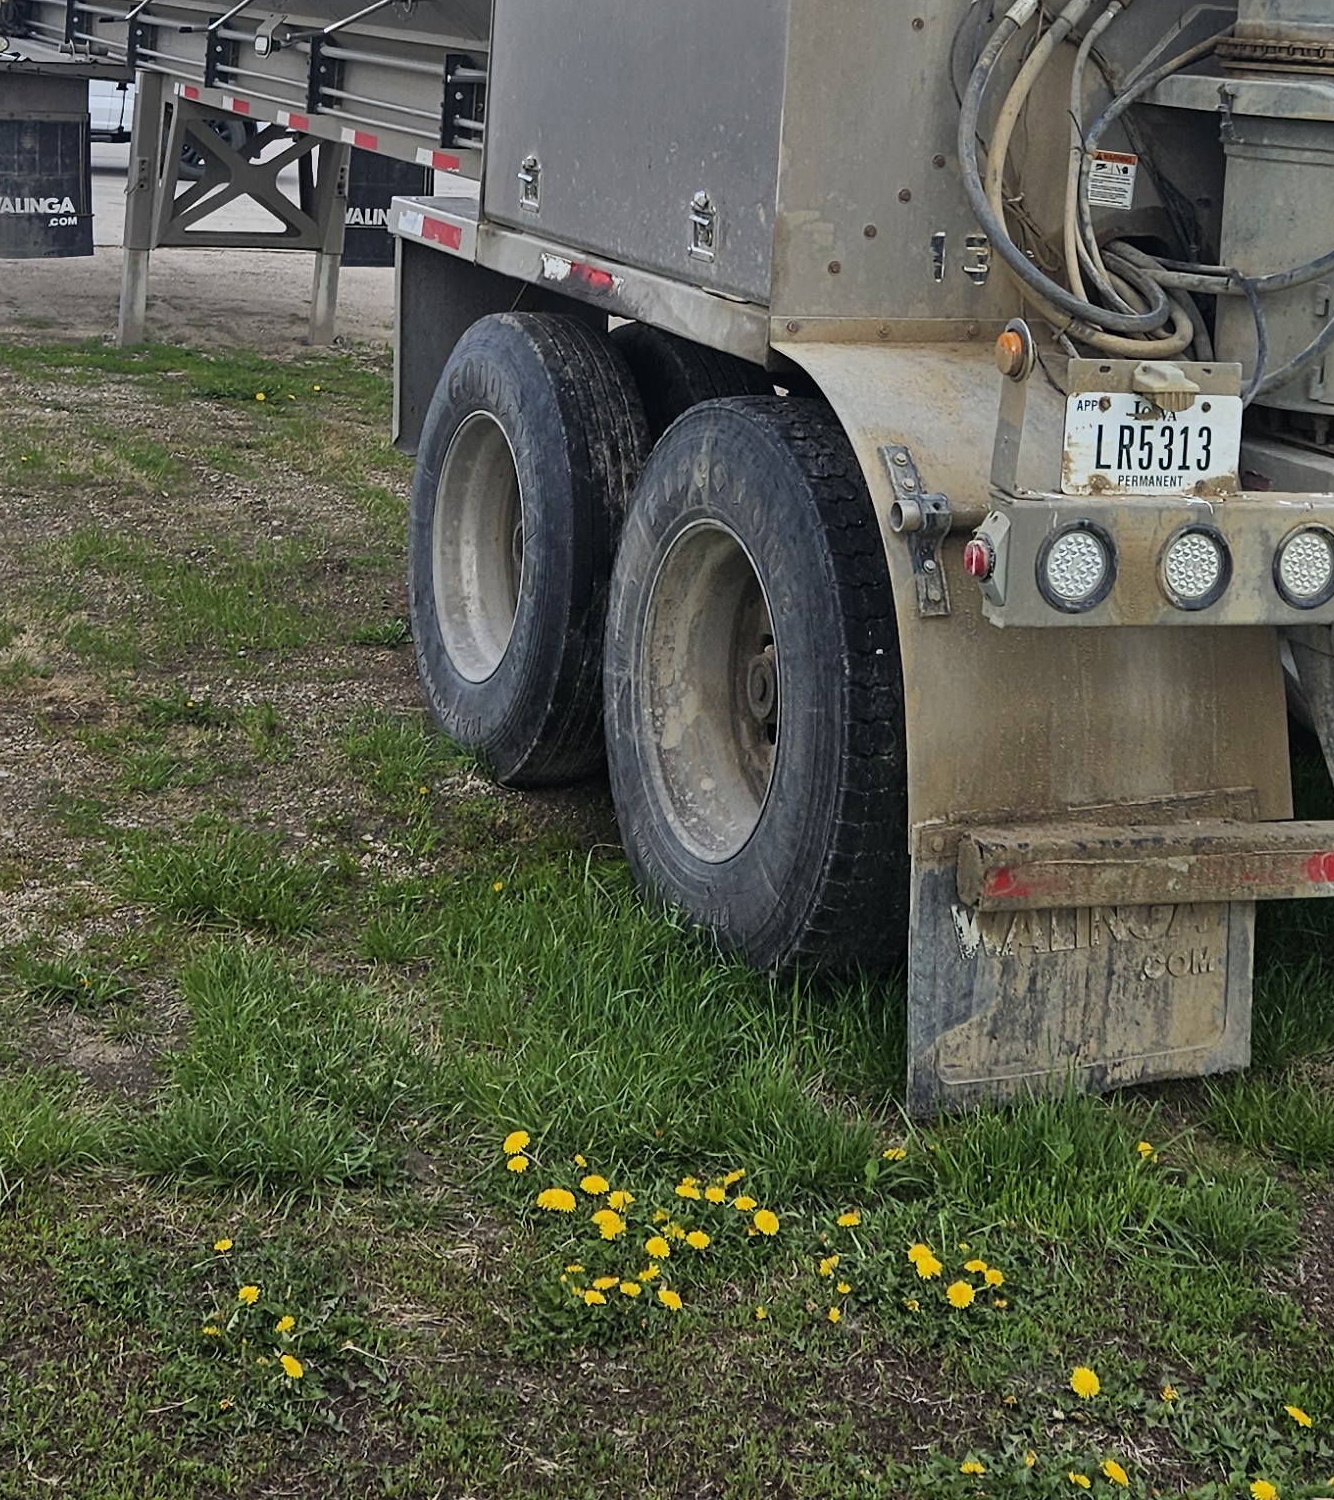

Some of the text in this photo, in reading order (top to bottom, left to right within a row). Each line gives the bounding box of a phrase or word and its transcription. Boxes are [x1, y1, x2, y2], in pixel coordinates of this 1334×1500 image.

[48, 216, 78, 227] .COM
[345, 207, 391, 226] ALIN
[1095, 424, 1213, 471] LR5313
[1117, 475, 1184, 488] PERMANENT
[950, 903, 1213, 960] WALINGA
[1140, 948, 1216, 981] .COM
